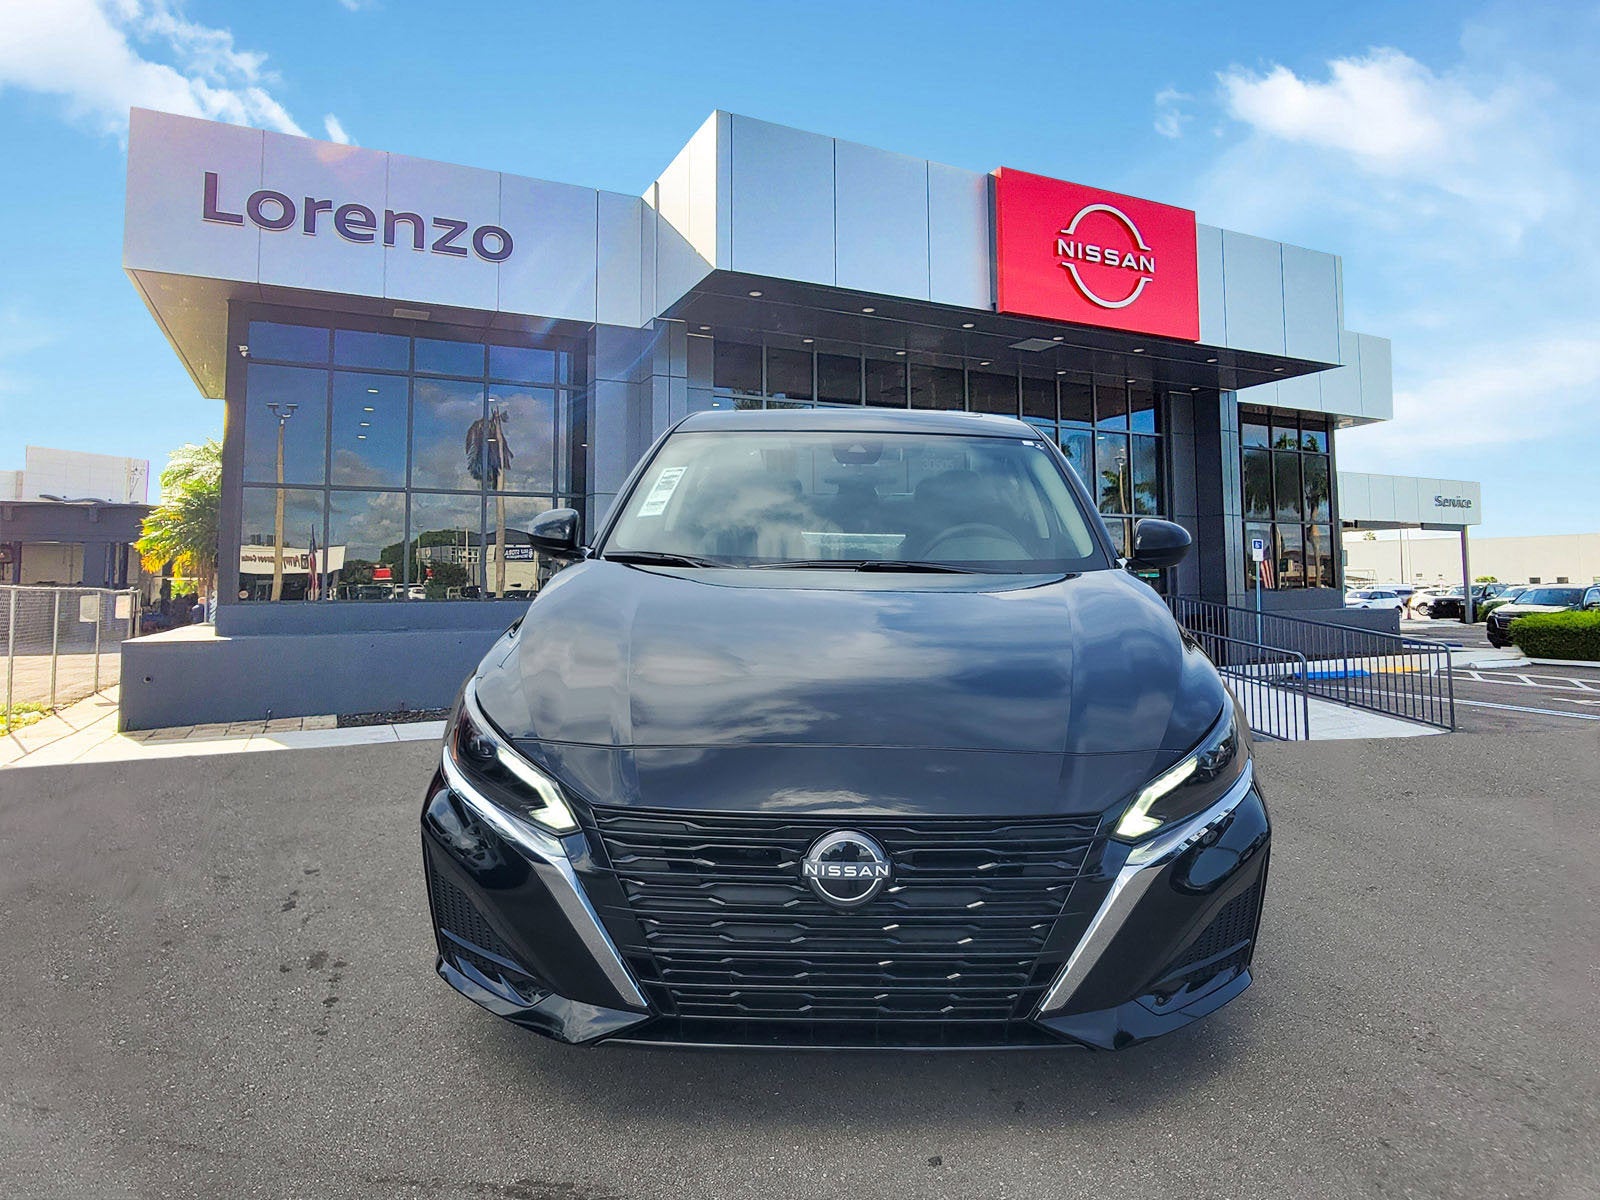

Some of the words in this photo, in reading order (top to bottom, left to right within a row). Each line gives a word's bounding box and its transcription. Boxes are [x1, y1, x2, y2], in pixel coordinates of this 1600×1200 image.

[202, 171, 514, 262] Lorenzo
[1057, 238, 1155, 273] NISSAN
[1434, 495, 1472, 509] Service
[804, 863, 889, 877] NISSAN
